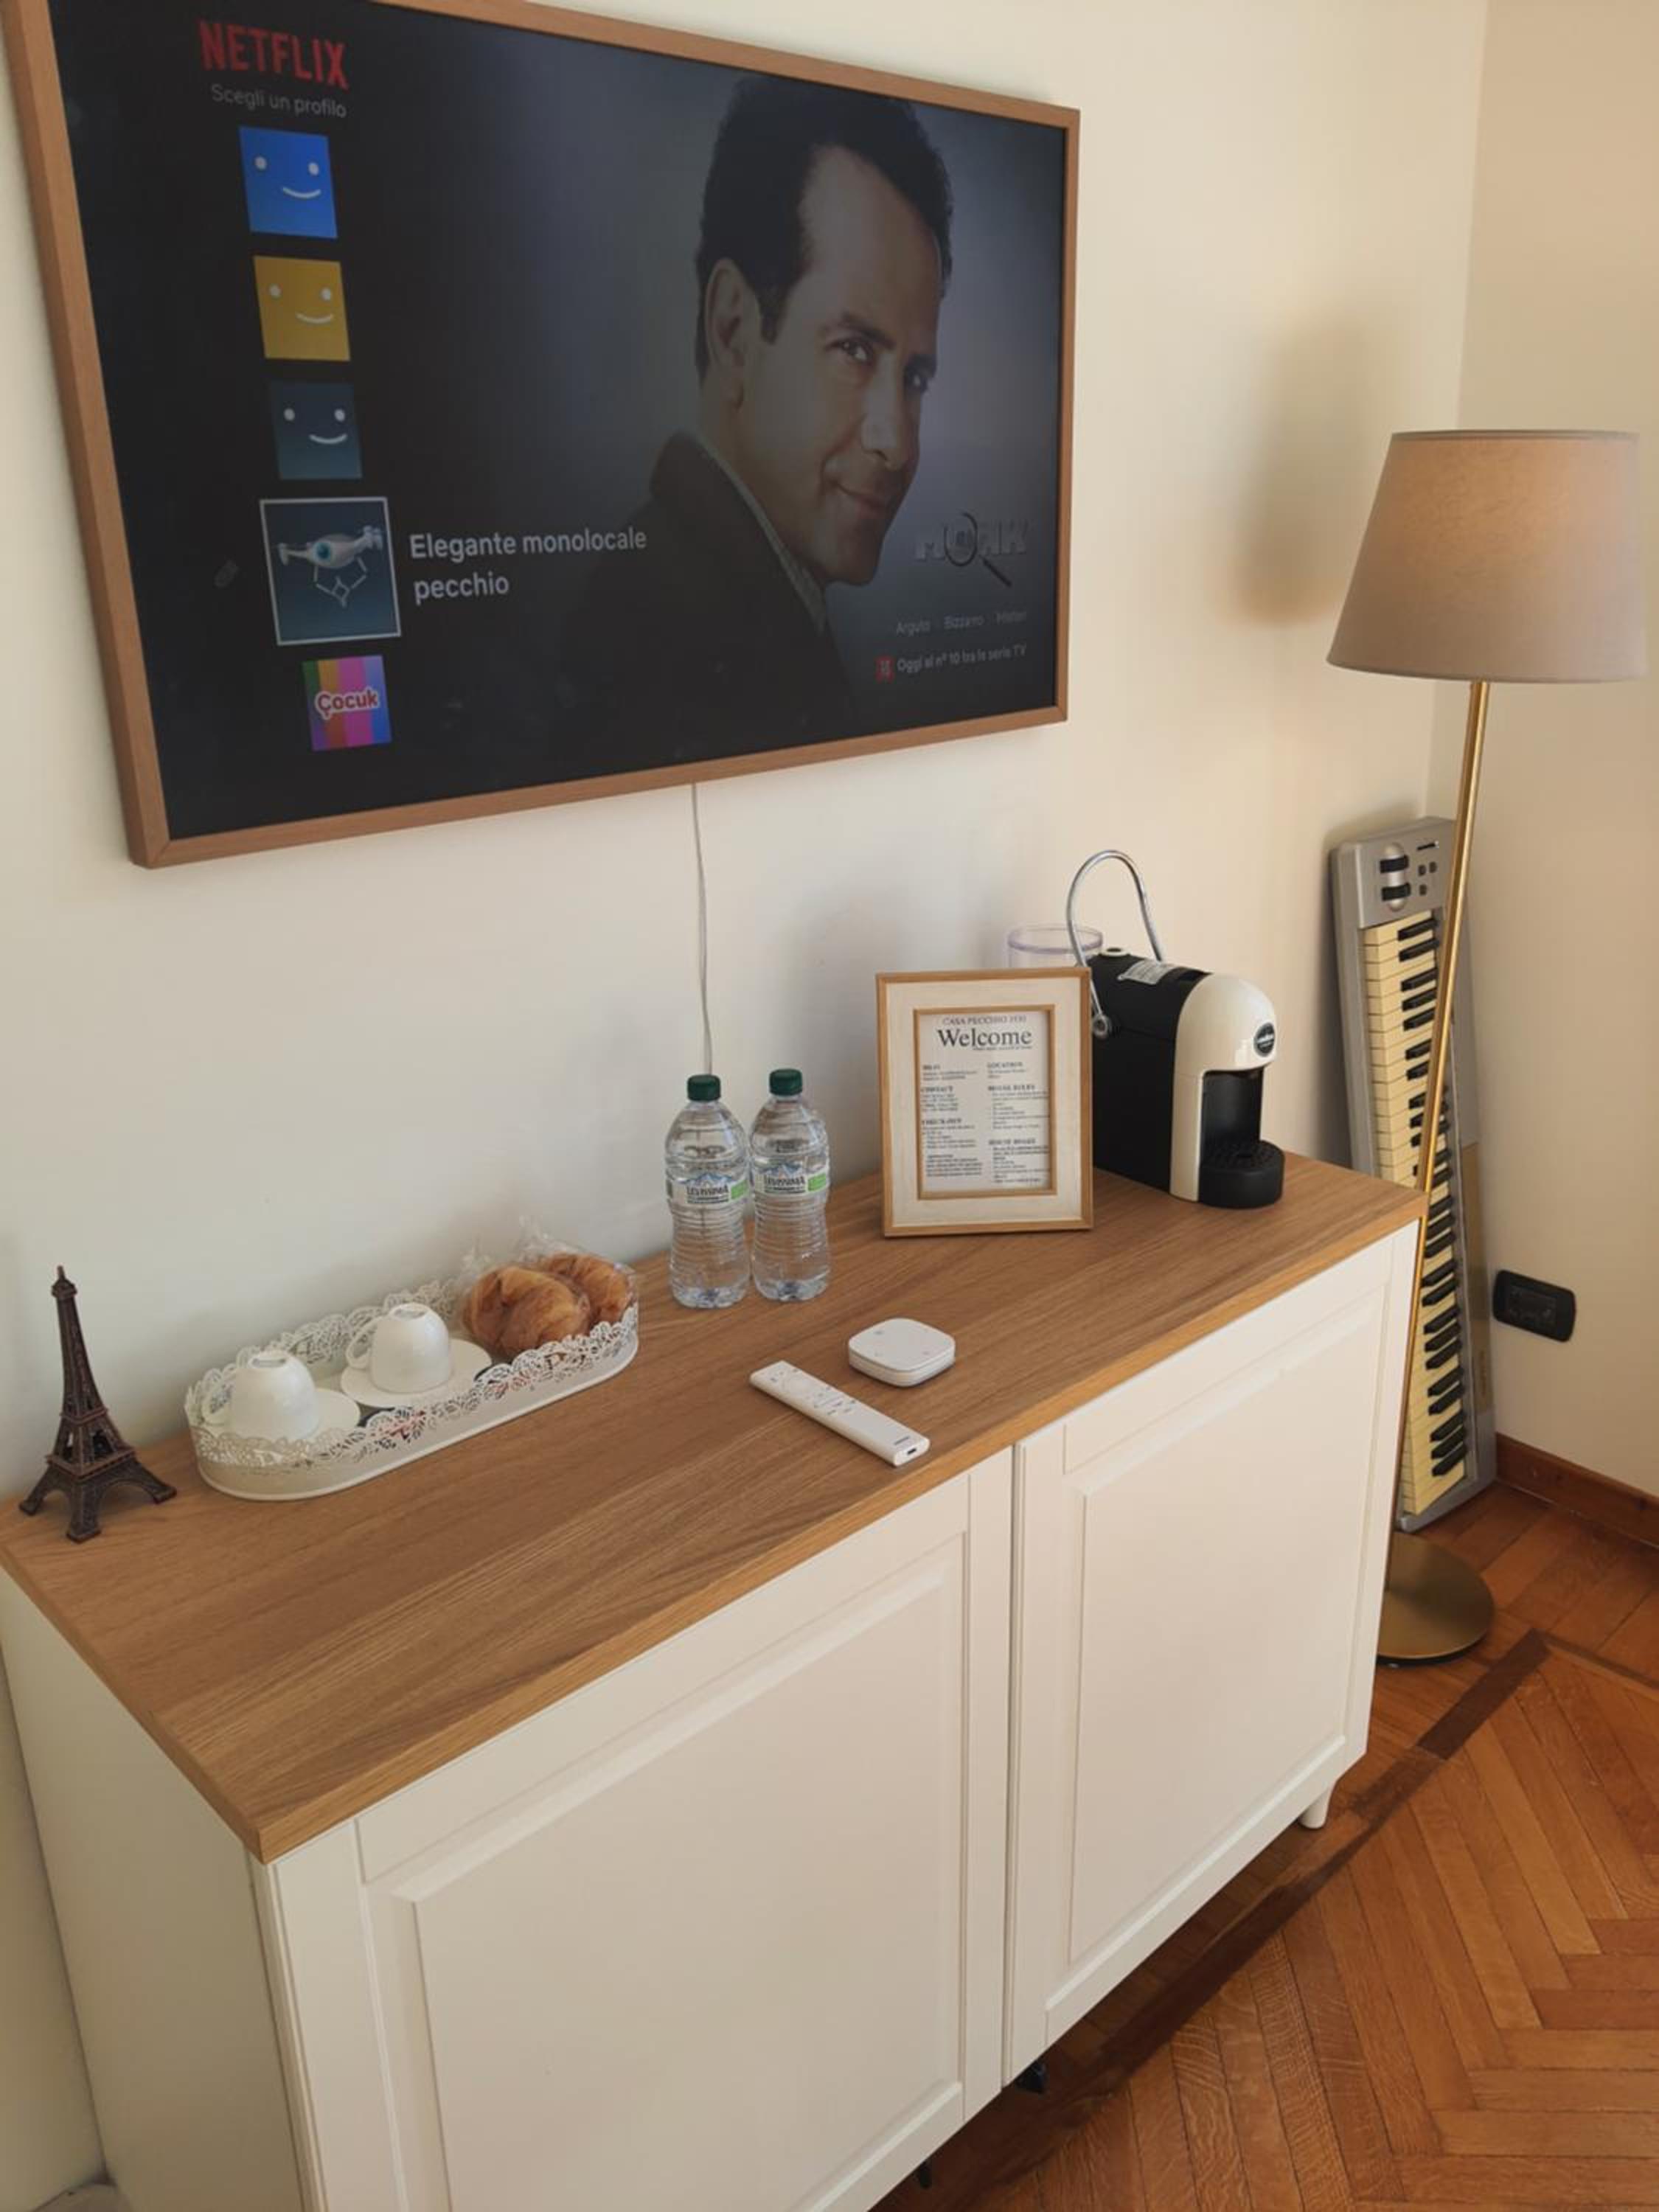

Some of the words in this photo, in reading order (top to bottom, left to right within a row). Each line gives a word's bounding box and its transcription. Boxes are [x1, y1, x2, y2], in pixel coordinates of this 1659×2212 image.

[197, 19, 349, 91] NETFLIX
[211, 83, 265, 111] Scegli
[268, 97, 291, 111] un
[294, 98, 347, 119] profilo
[409, 532, 517, 563] Elegante
[522, 526, 647, 554] monolocale
[413, 570, 510, 605] pecchio
[897, 655, 922, 673] Oggi
[1013, 642, 1027, 656] TV
[317, 688, 379, 719] Çocuk
[937, 1028, 1032, 1048] Welcome
